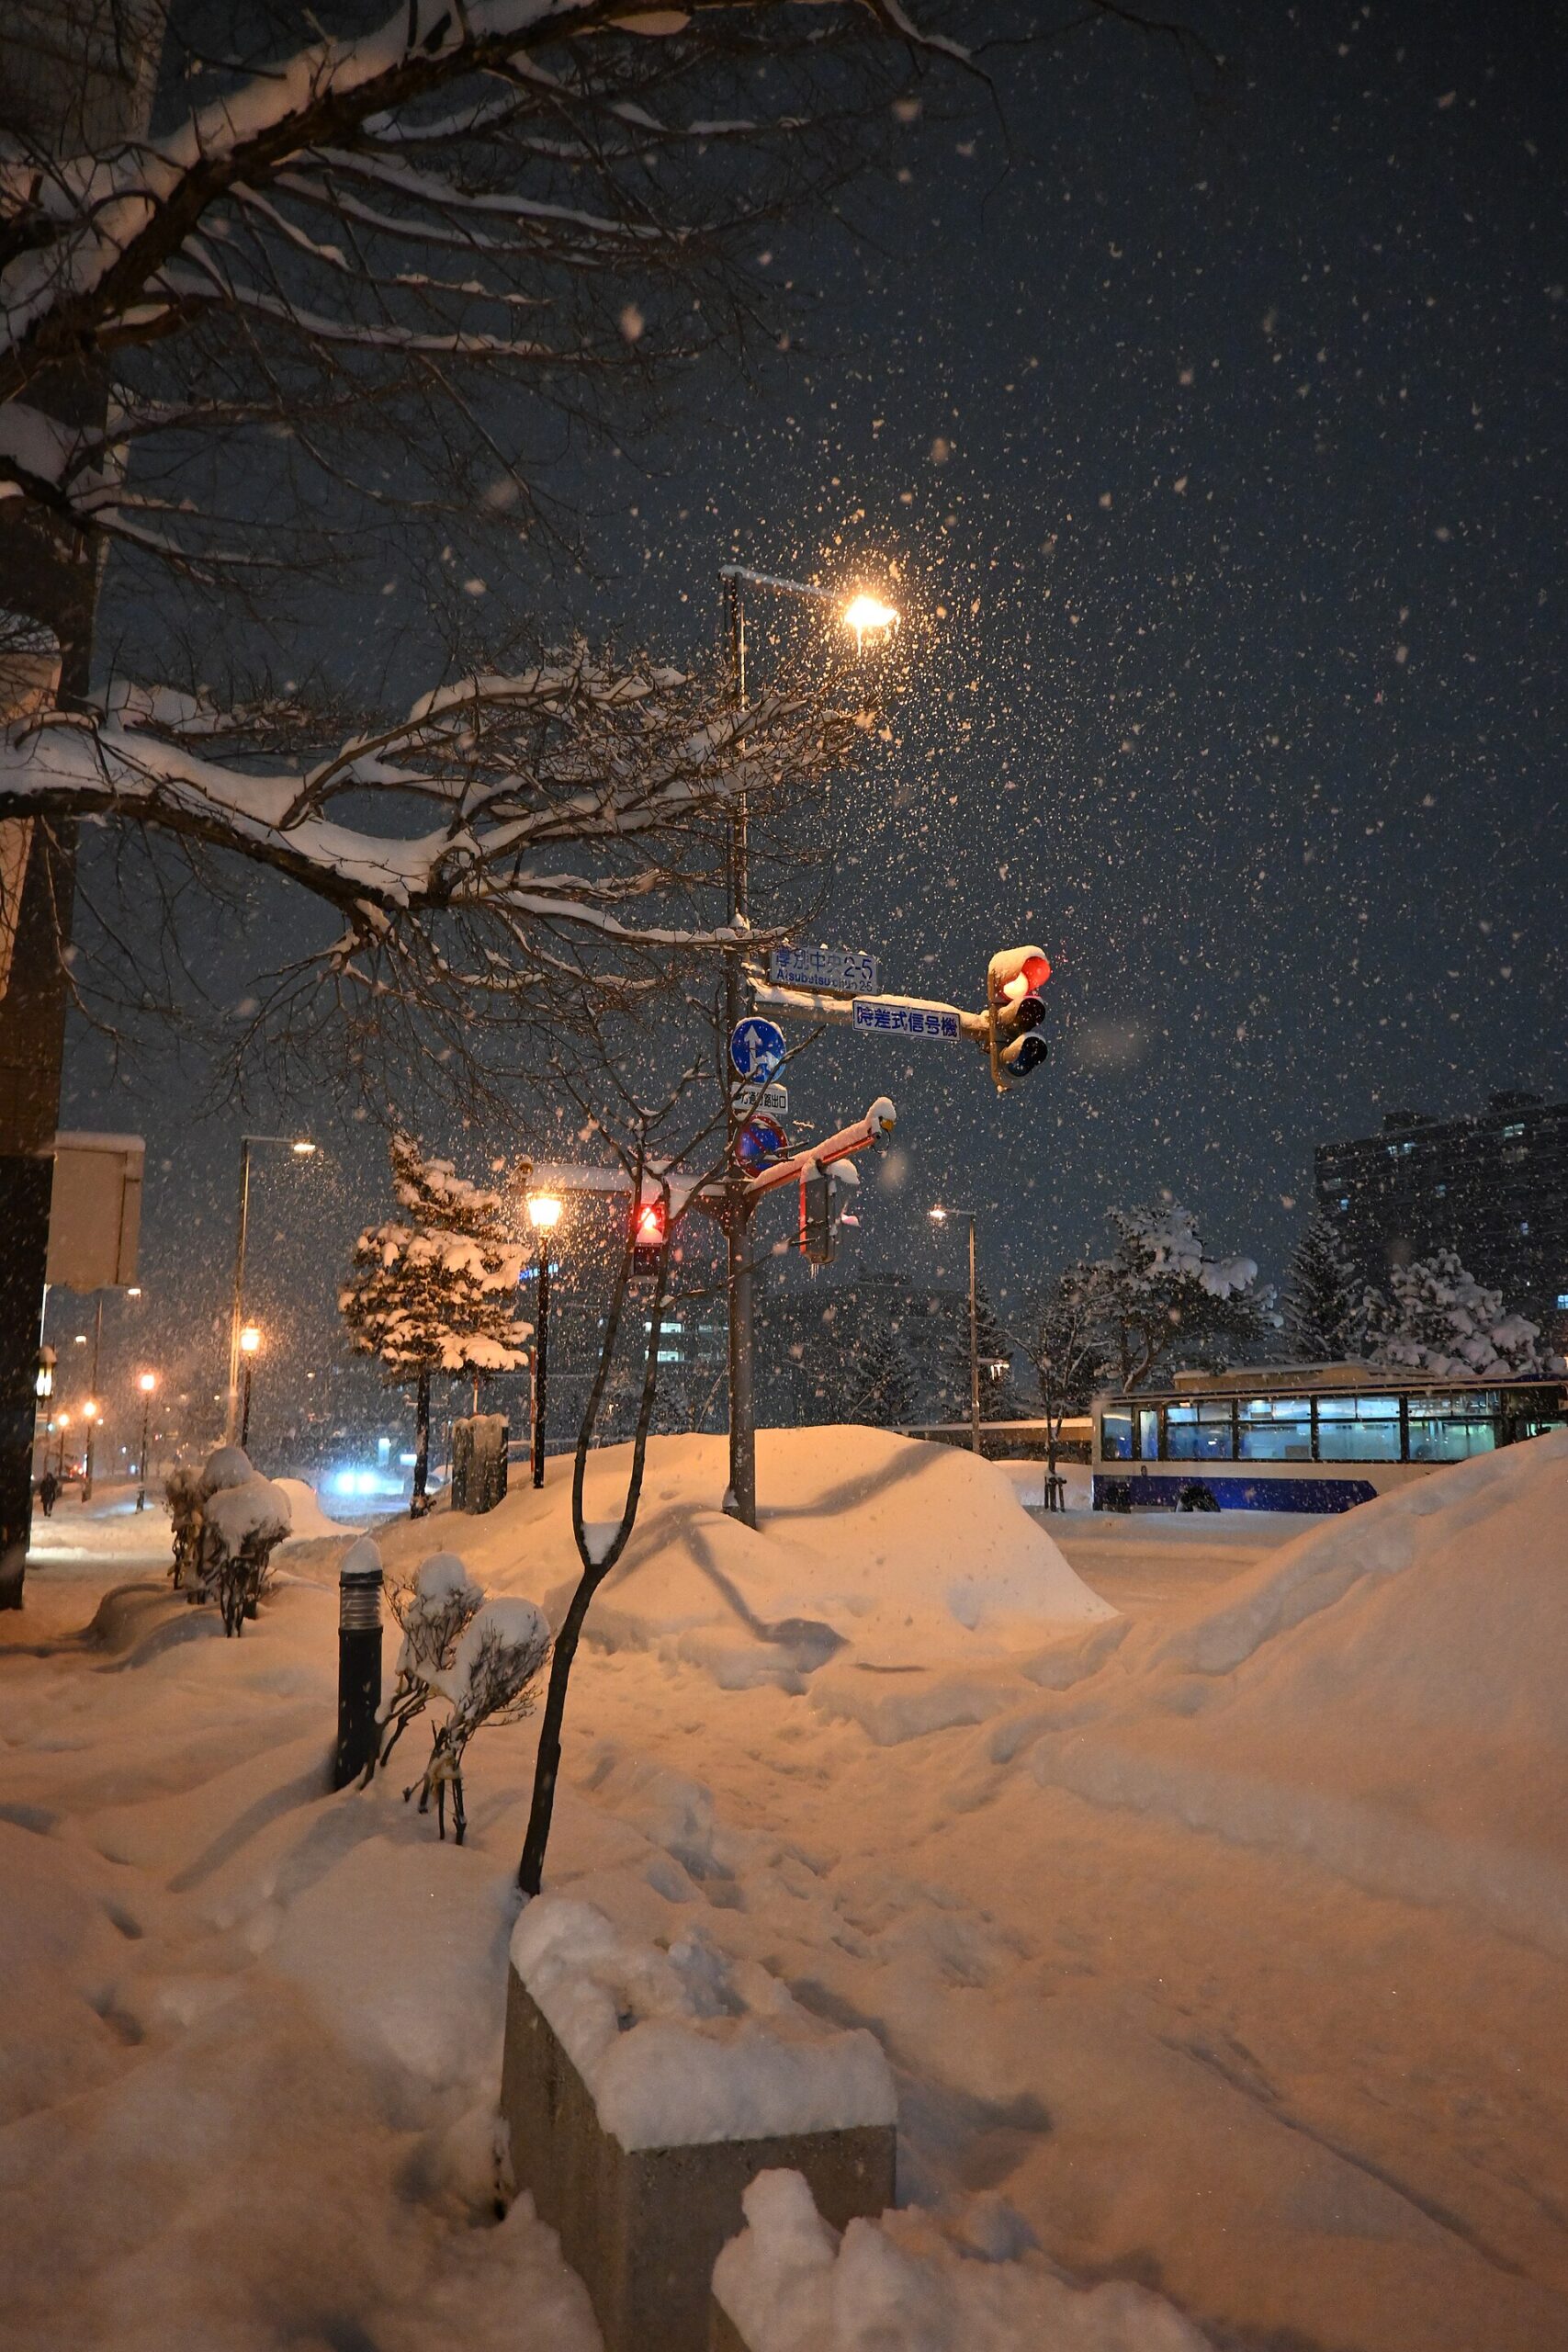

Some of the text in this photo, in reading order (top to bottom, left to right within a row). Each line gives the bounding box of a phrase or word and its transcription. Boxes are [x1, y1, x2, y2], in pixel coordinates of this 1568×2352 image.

[856, 1005, 958, 1038] 時差式信号機
